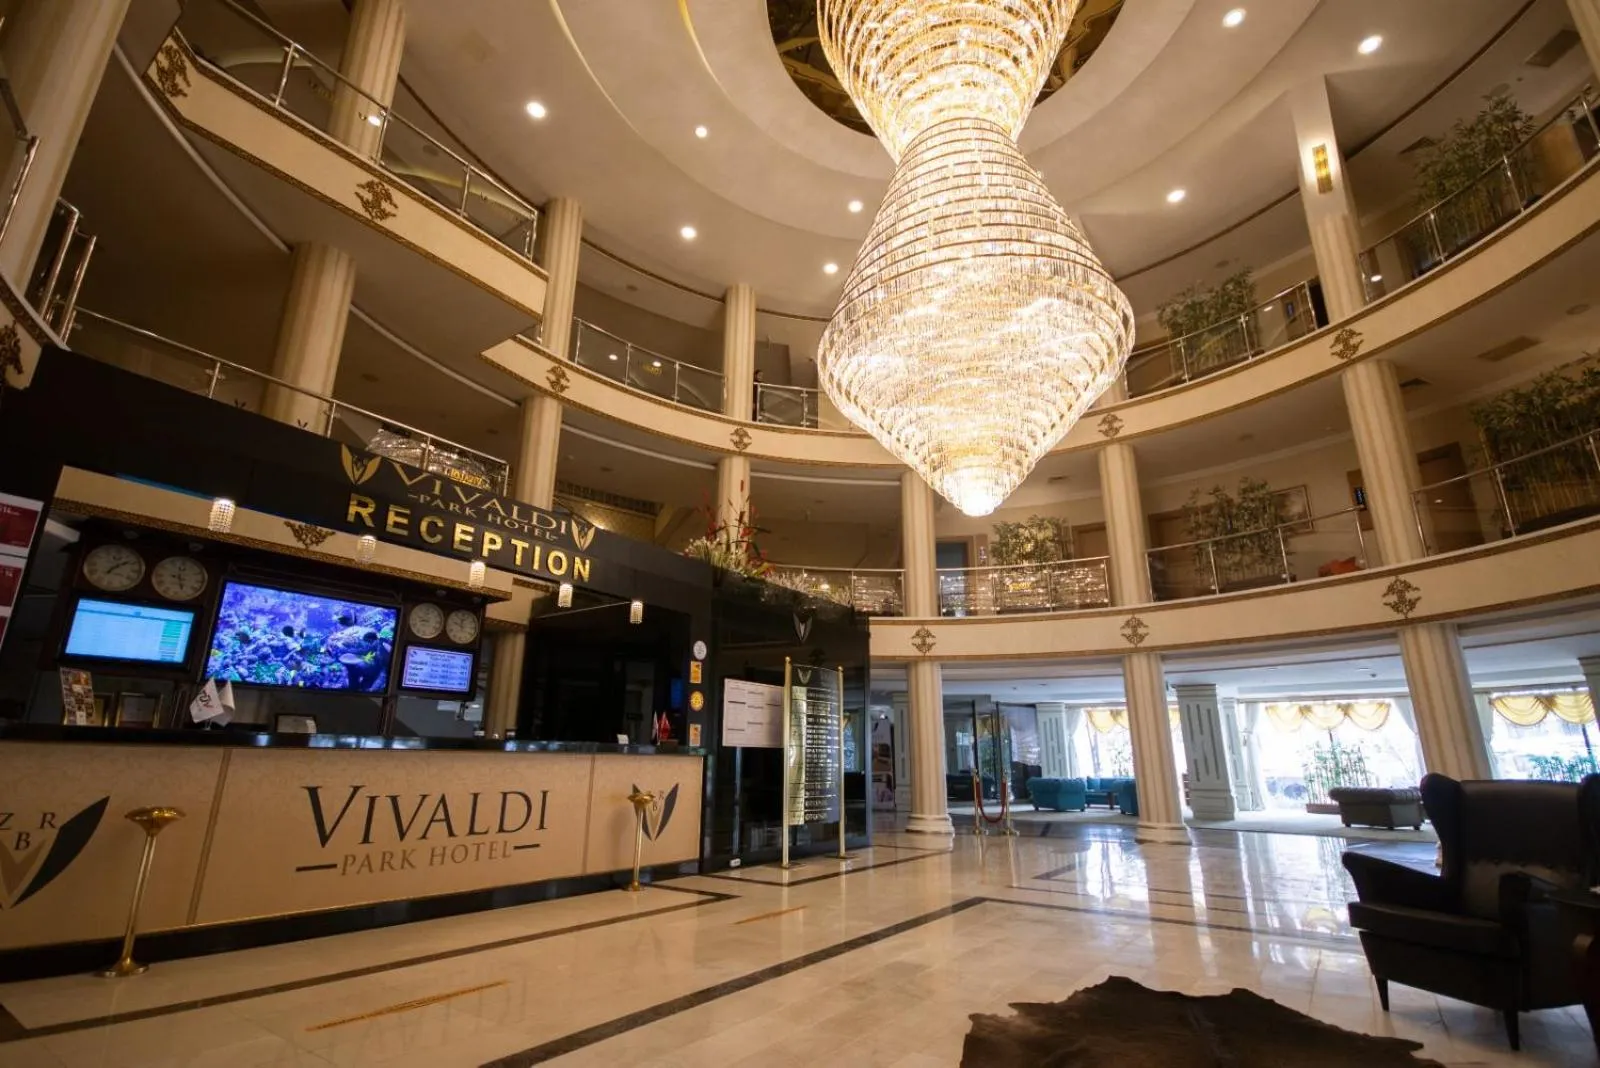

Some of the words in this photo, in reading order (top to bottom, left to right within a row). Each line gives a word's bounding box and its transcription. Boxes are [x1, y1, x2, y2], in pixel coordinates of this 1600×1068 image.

[392, 460, 568, 535] VIVALDI
[420, 495, 477, 518] PARK
[488, 512, 553, 540] HOTEL
[346, 492, 591, 583] RECEPTION
[341, 848, 418, 877] PARK
[429, 839, 513, 867] HOTEL
